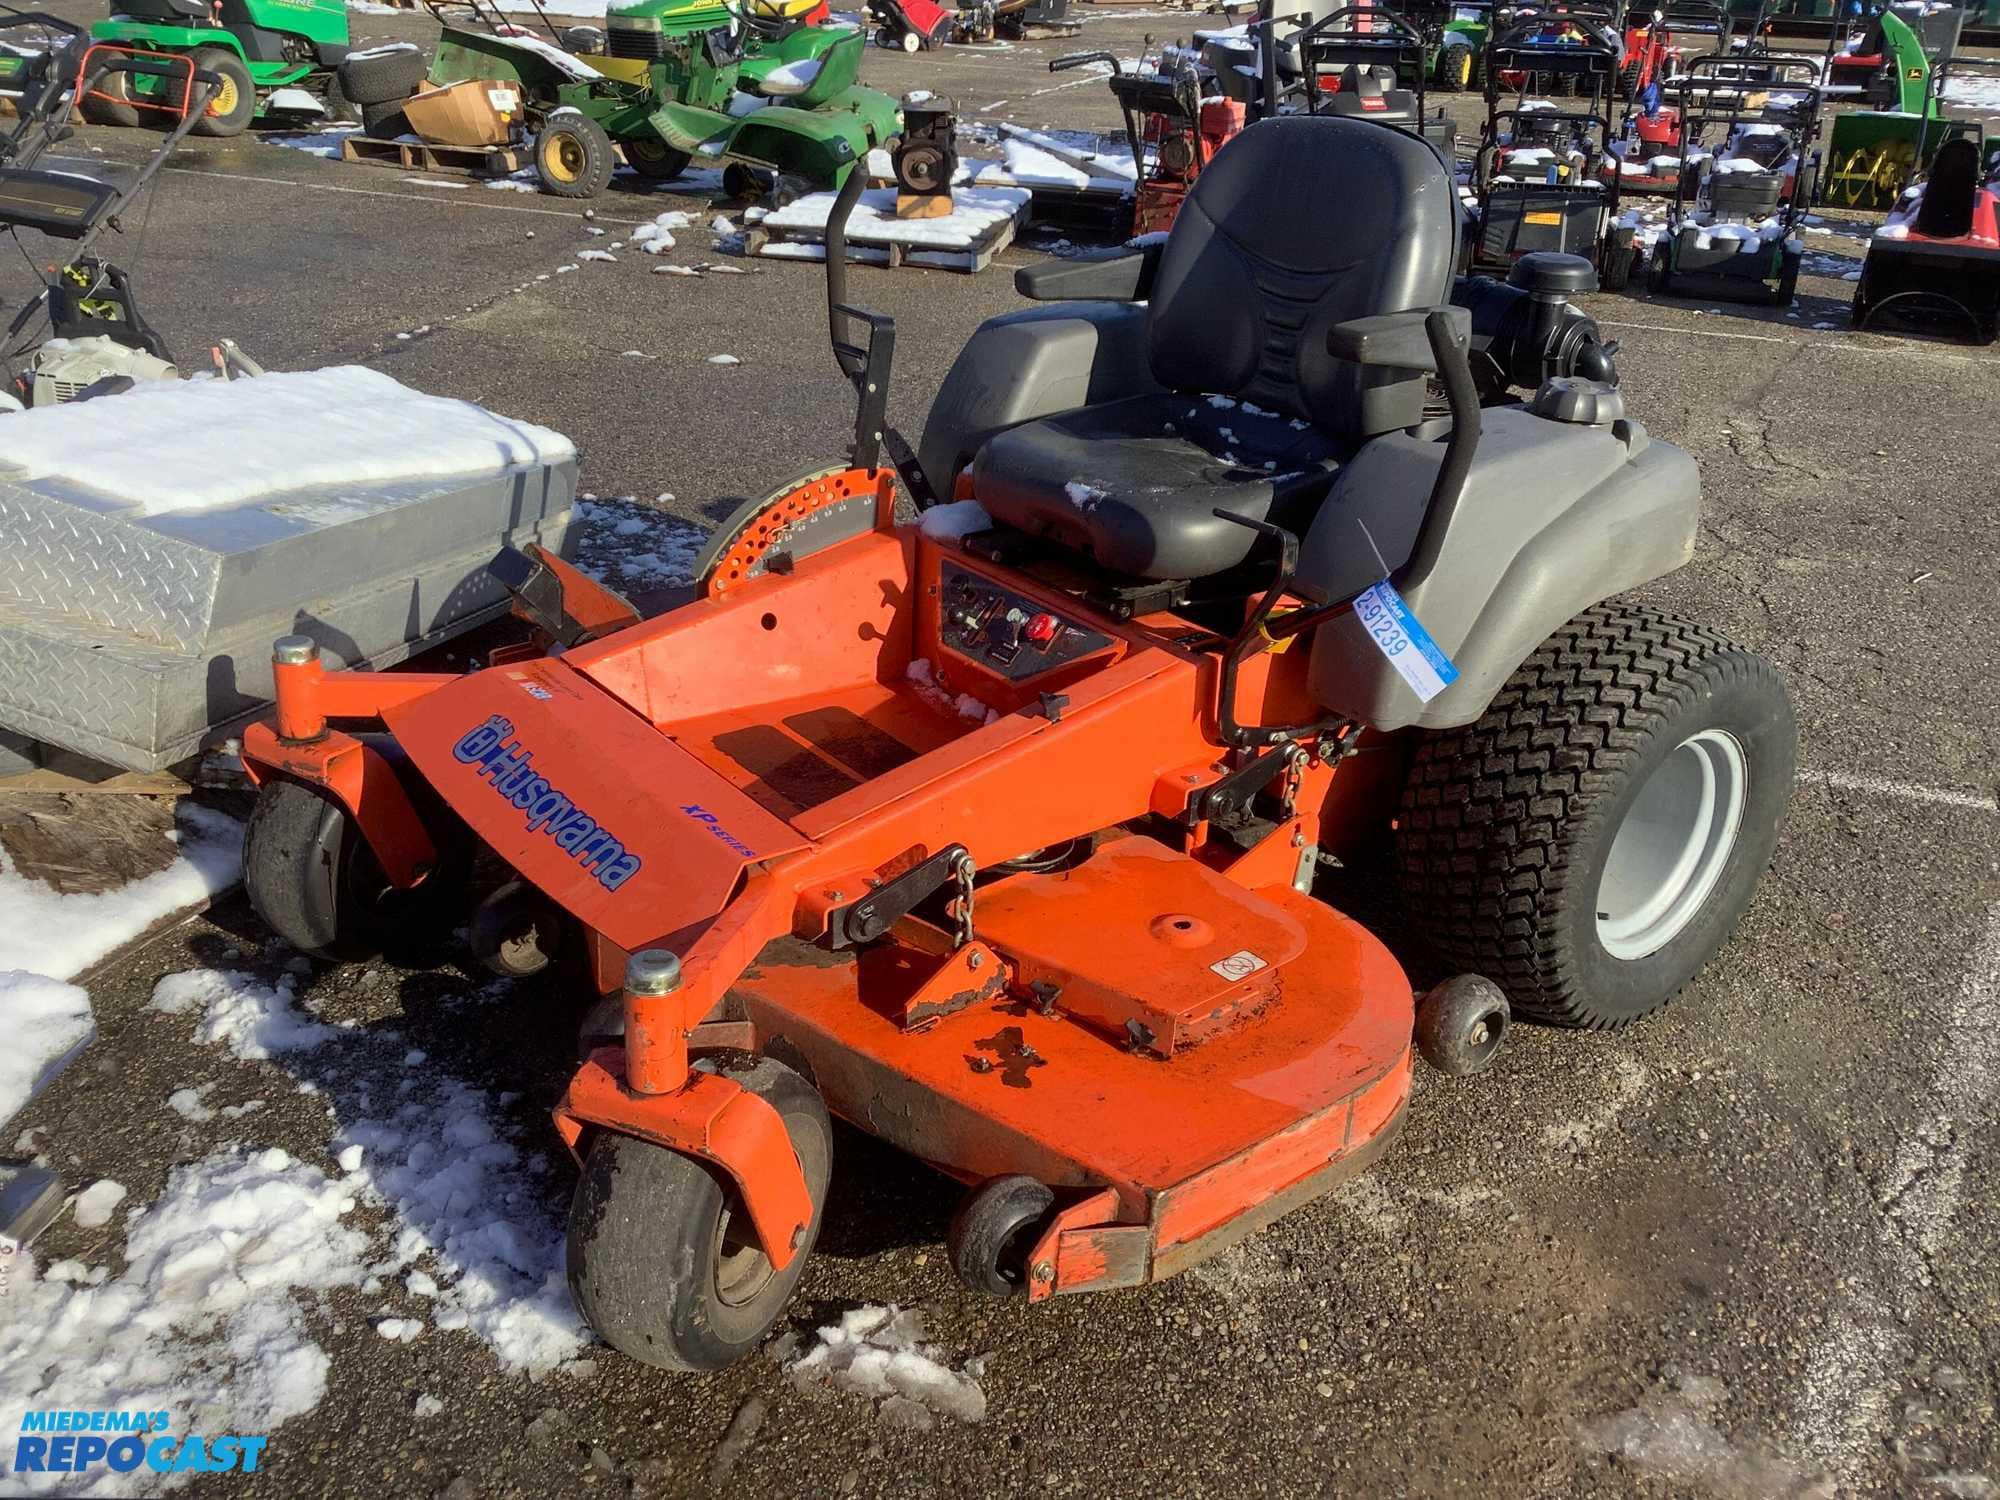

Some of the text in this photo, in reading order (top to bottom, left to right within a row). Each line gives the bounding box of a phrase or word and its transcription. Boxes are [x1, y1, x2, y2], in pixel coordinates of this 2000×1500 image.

[1356, 591, 1409, 656] 2-91239
[477, 741, 642, 893] Husqvarna
[680, 804, 757, 857] XP SERIES
